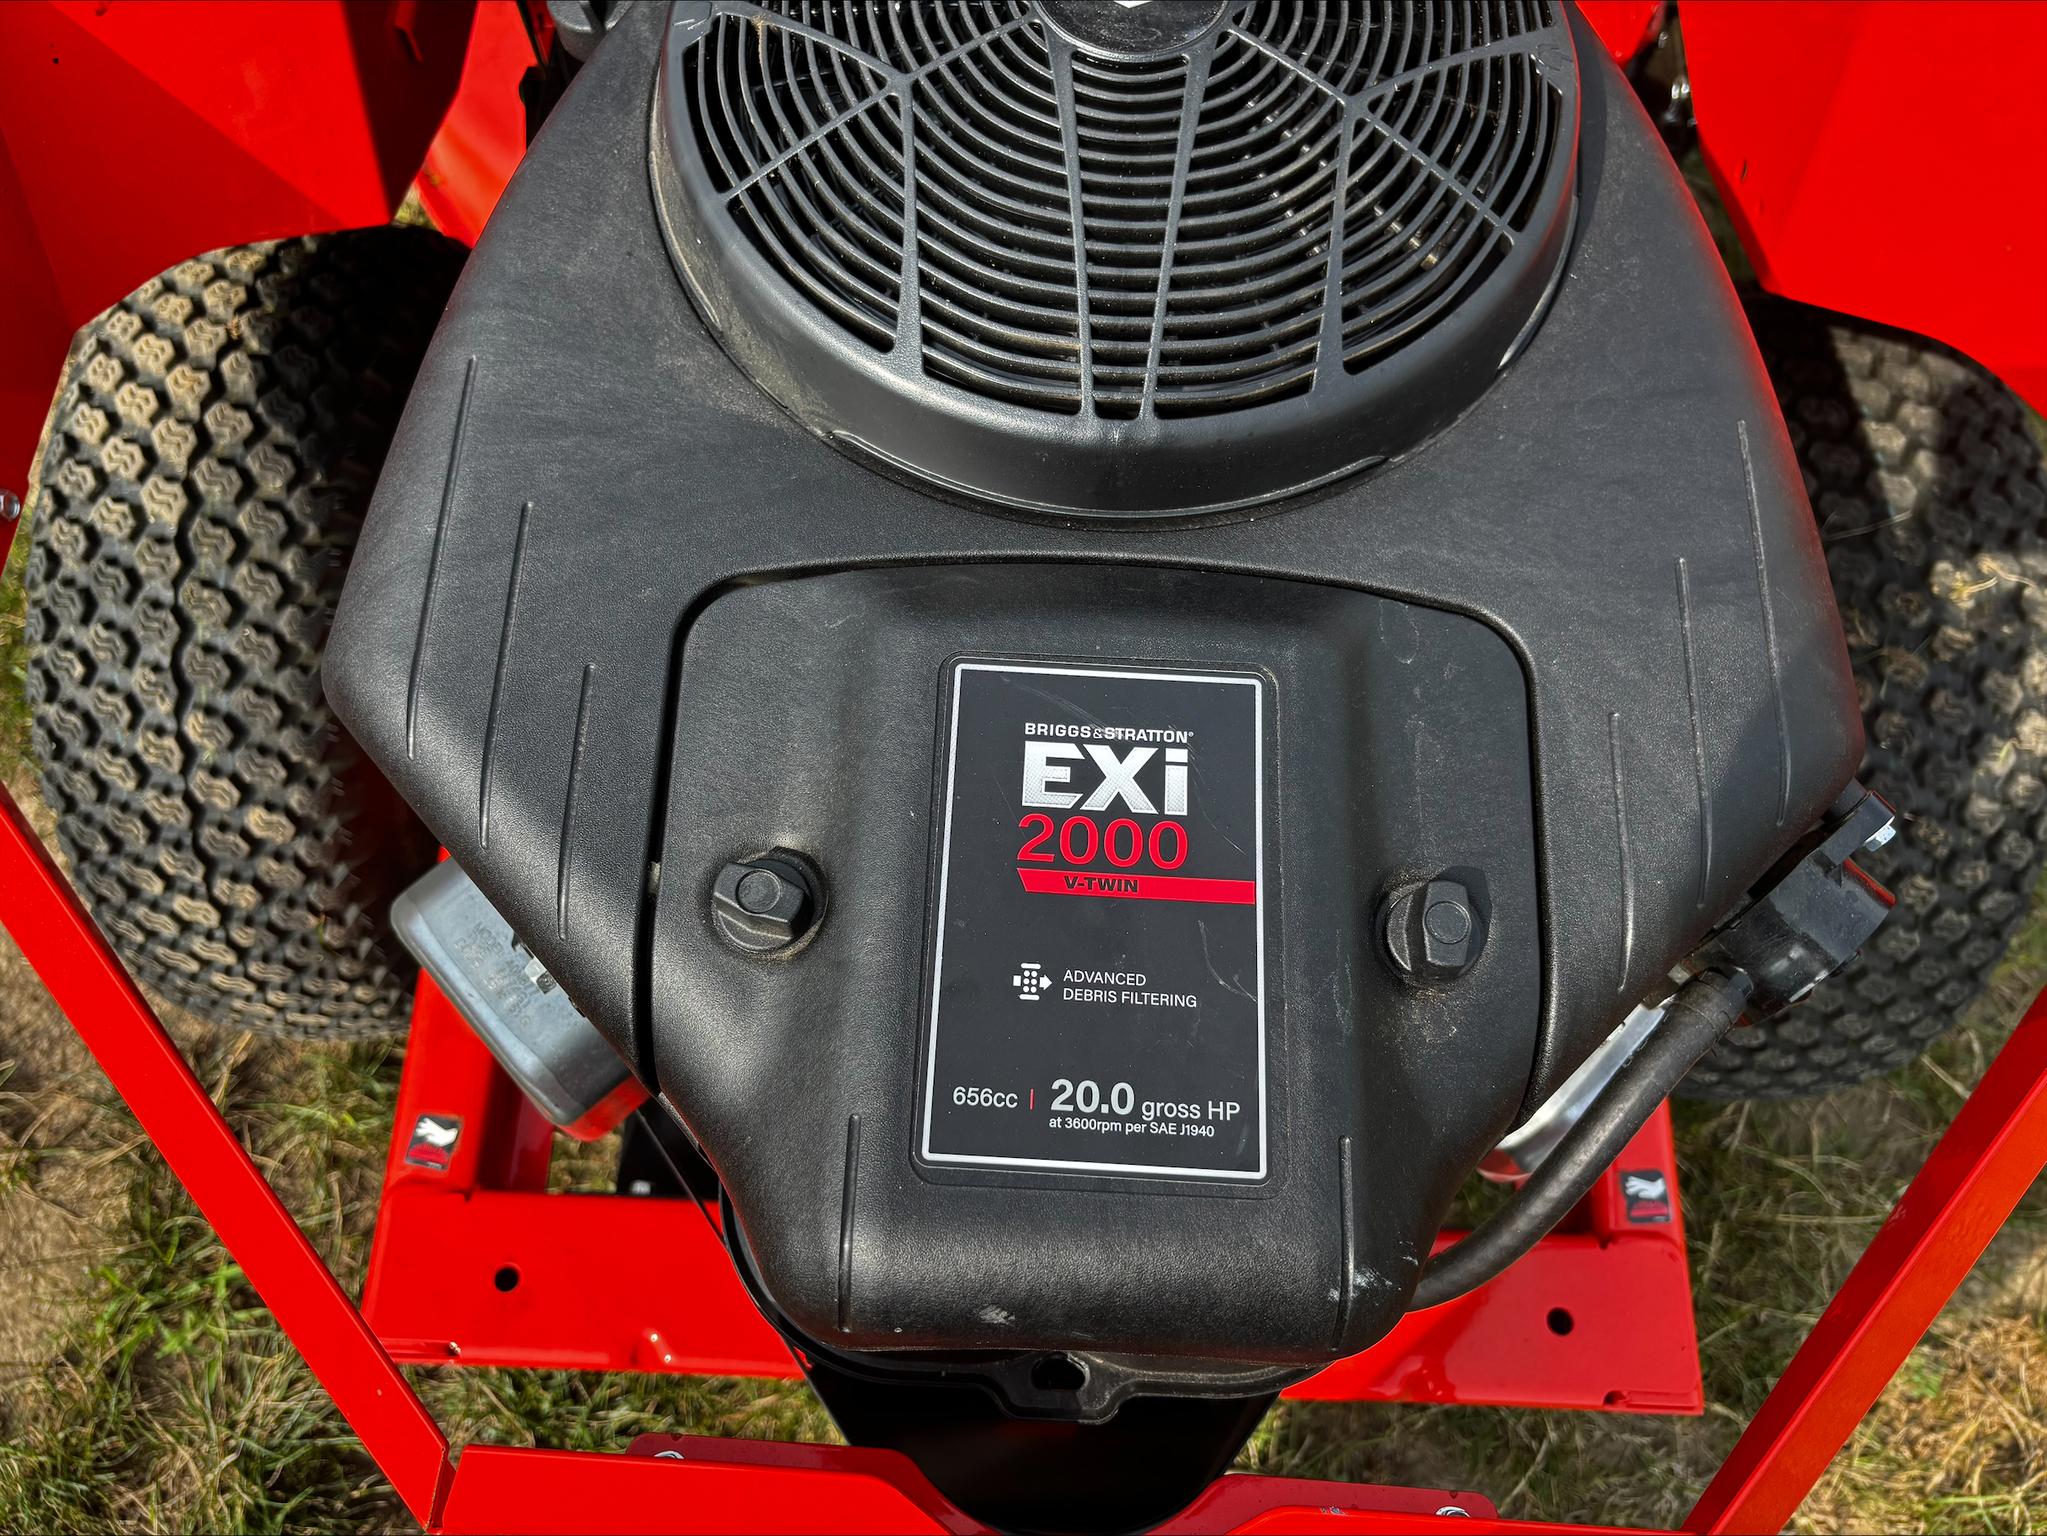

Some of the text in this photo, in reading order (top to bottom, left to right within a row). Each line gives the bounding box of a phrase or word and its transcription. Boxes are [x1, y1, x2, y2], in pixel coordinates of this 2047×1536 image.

[1022, 741, 1189, 815] EXi
[1017, 814, 1188, 870] 2000
[1065, 876, 1138, 893] V-TWIN
[472, 922, 504, 957] MODEL
[1063, 968, 1146, 986] ADVANCED
[1064, 988, 1196, 1007] DEBRIS FILTERING
[953, 1079, 1240, 1121] 656cc 20.0 gross HP
[1049, 1117, 1214, 1137] at 3600rpm per SAE J1940
